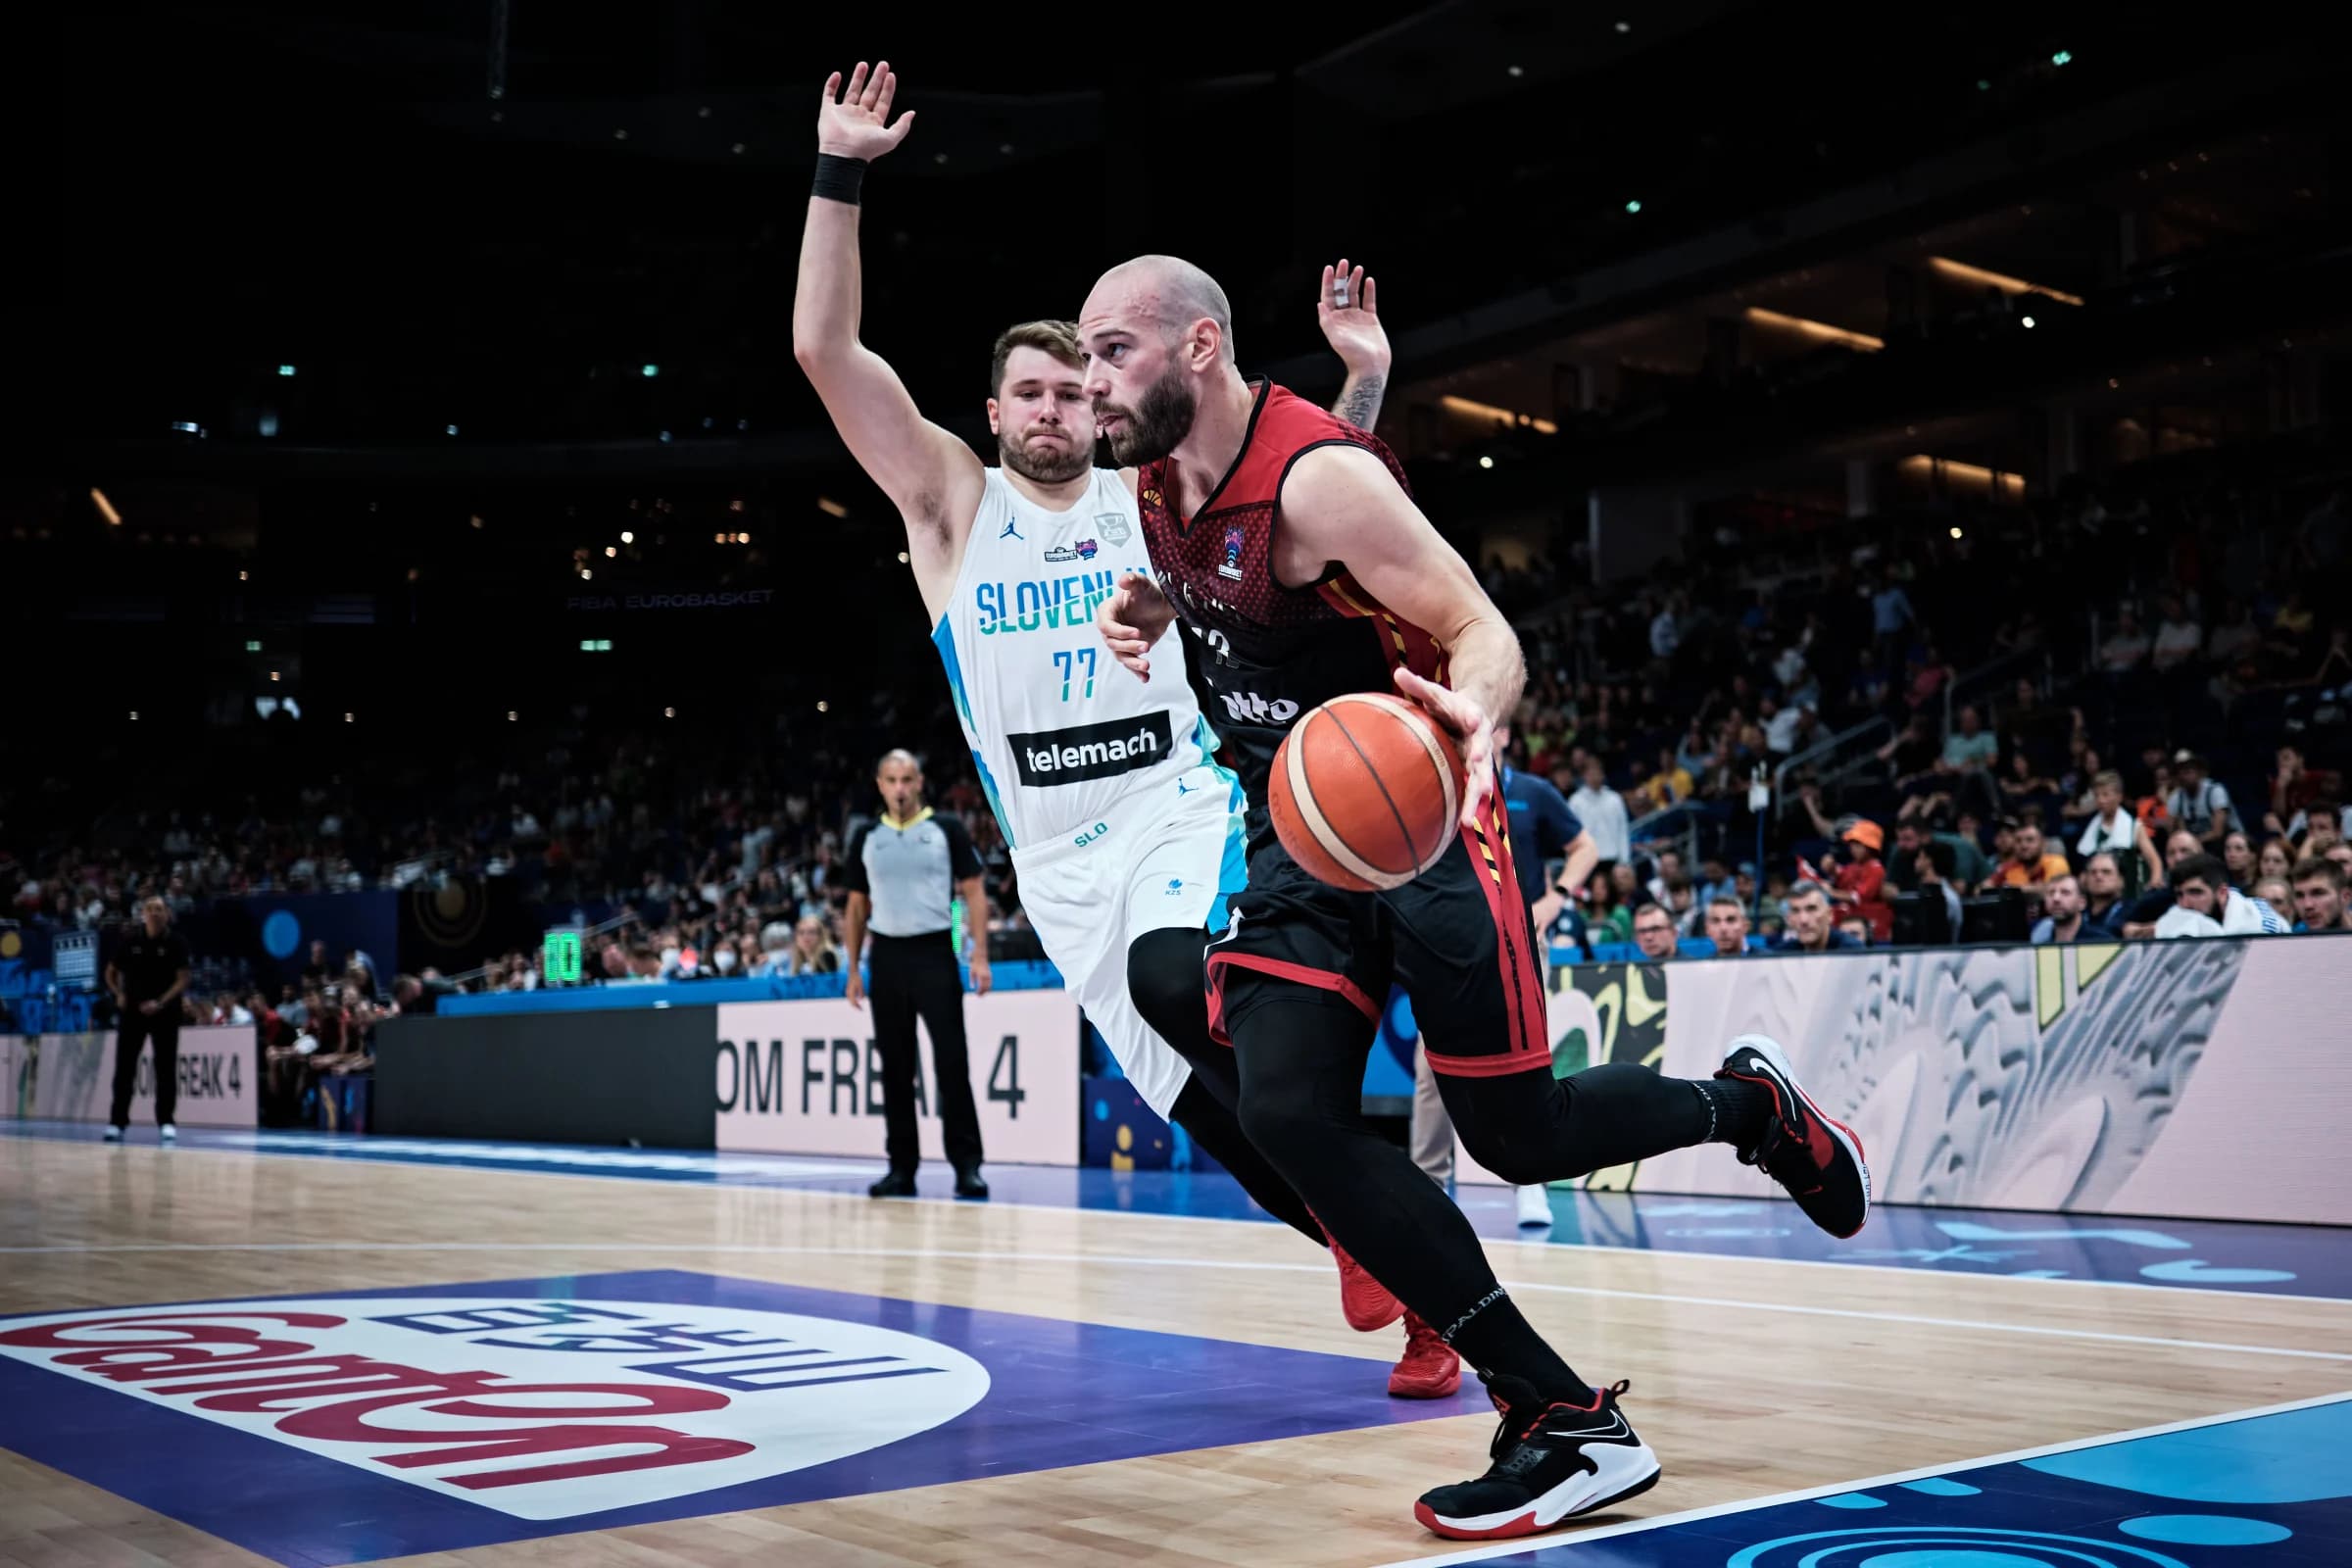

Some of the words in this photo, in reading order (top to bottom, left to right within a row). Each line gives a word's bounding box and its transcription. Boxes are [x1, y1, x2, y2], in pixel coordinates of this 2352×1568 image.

[624, 588, 776, 609] EUROBASKET
[976, 567, 1149, 635] SLOVENI
[1054, 648, 1097, 702] 77
[1026, 728, 1157, 772] telemach
[1074, 822, 1108, 848] SLO
[177, 1054, 223, 1099] REAK
[228, 1054, 241, 1099] 4
[988, 1036, 1025, 1119] 4
